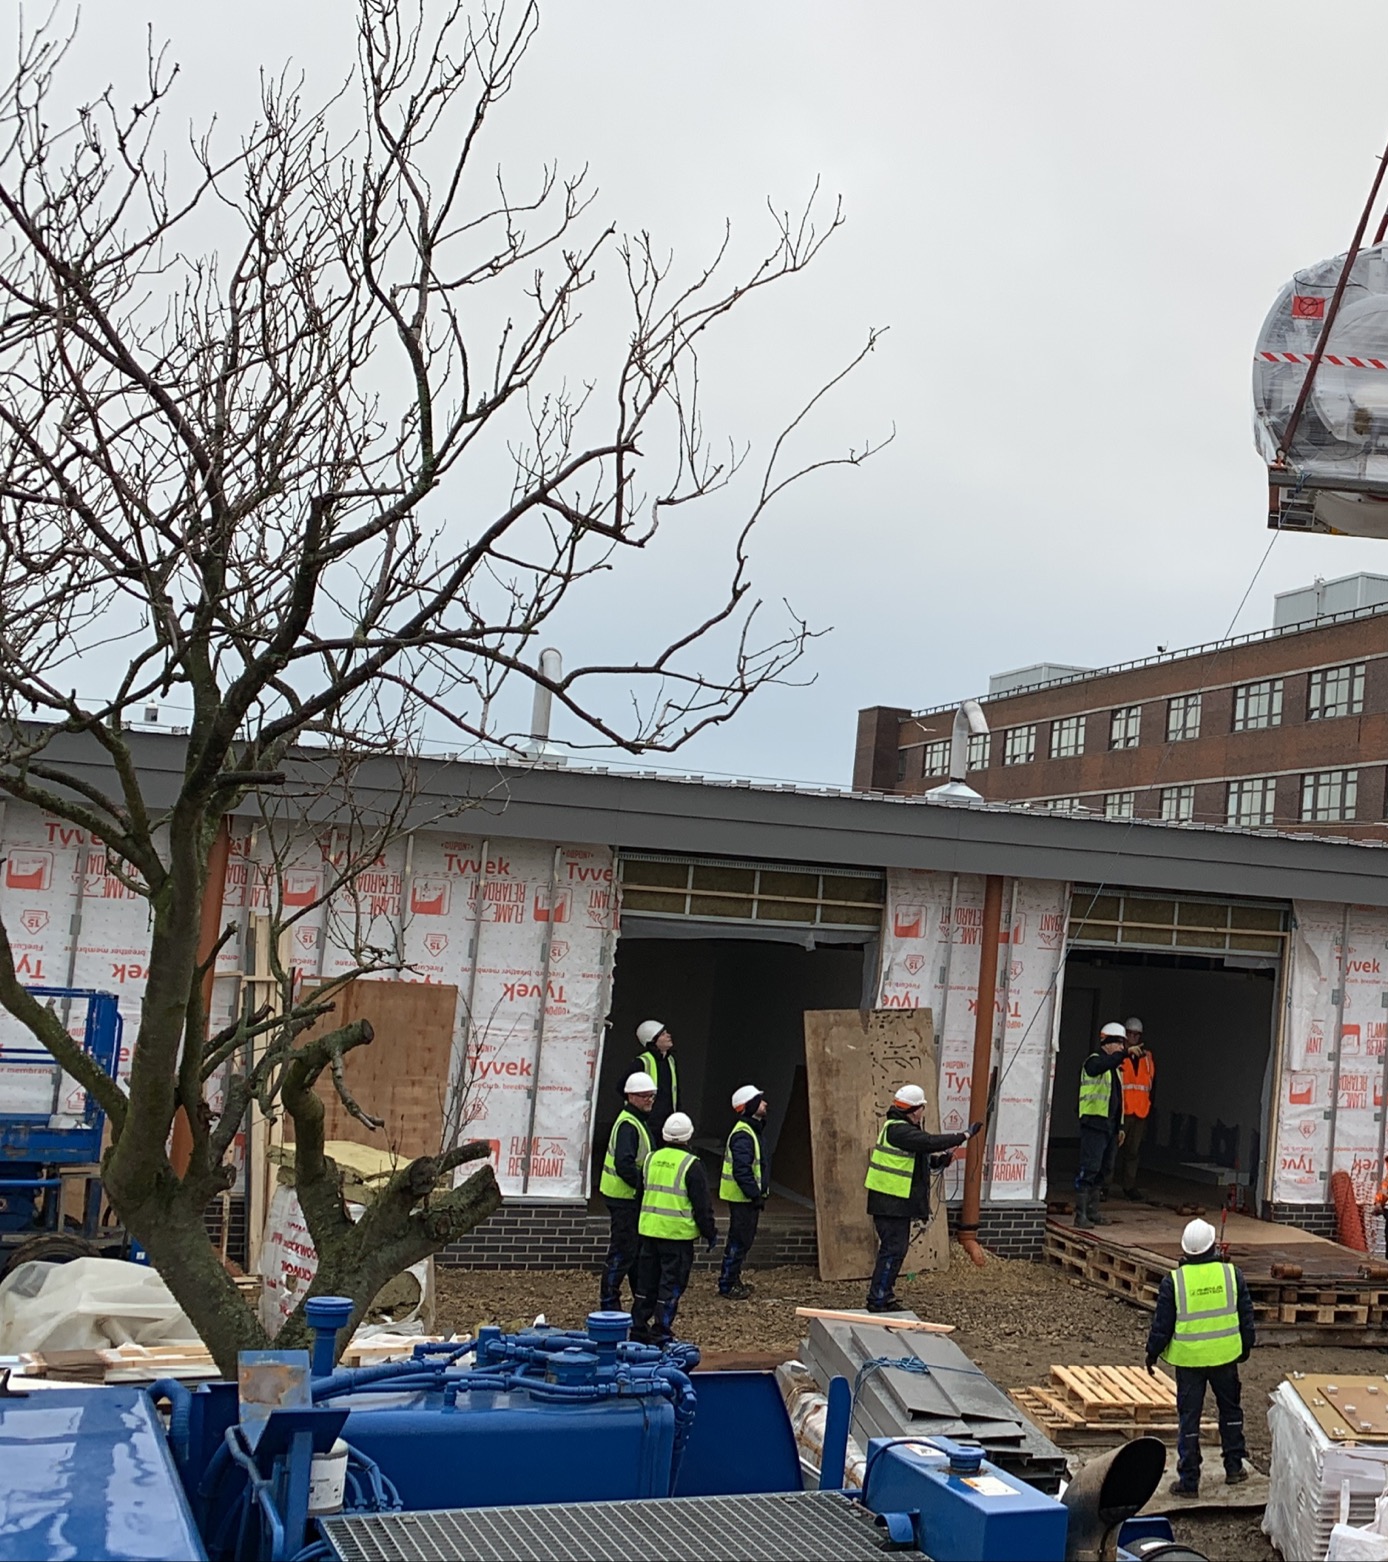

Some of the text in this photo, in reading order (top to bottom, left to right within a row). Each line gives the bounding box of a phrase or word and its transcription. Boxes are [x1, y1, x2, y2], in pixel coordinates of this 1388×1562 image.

[28, 919, 39, 927] 15
[552, 948, 561, 956] 15
[467, 1056, 532, 1079] Tyvek
